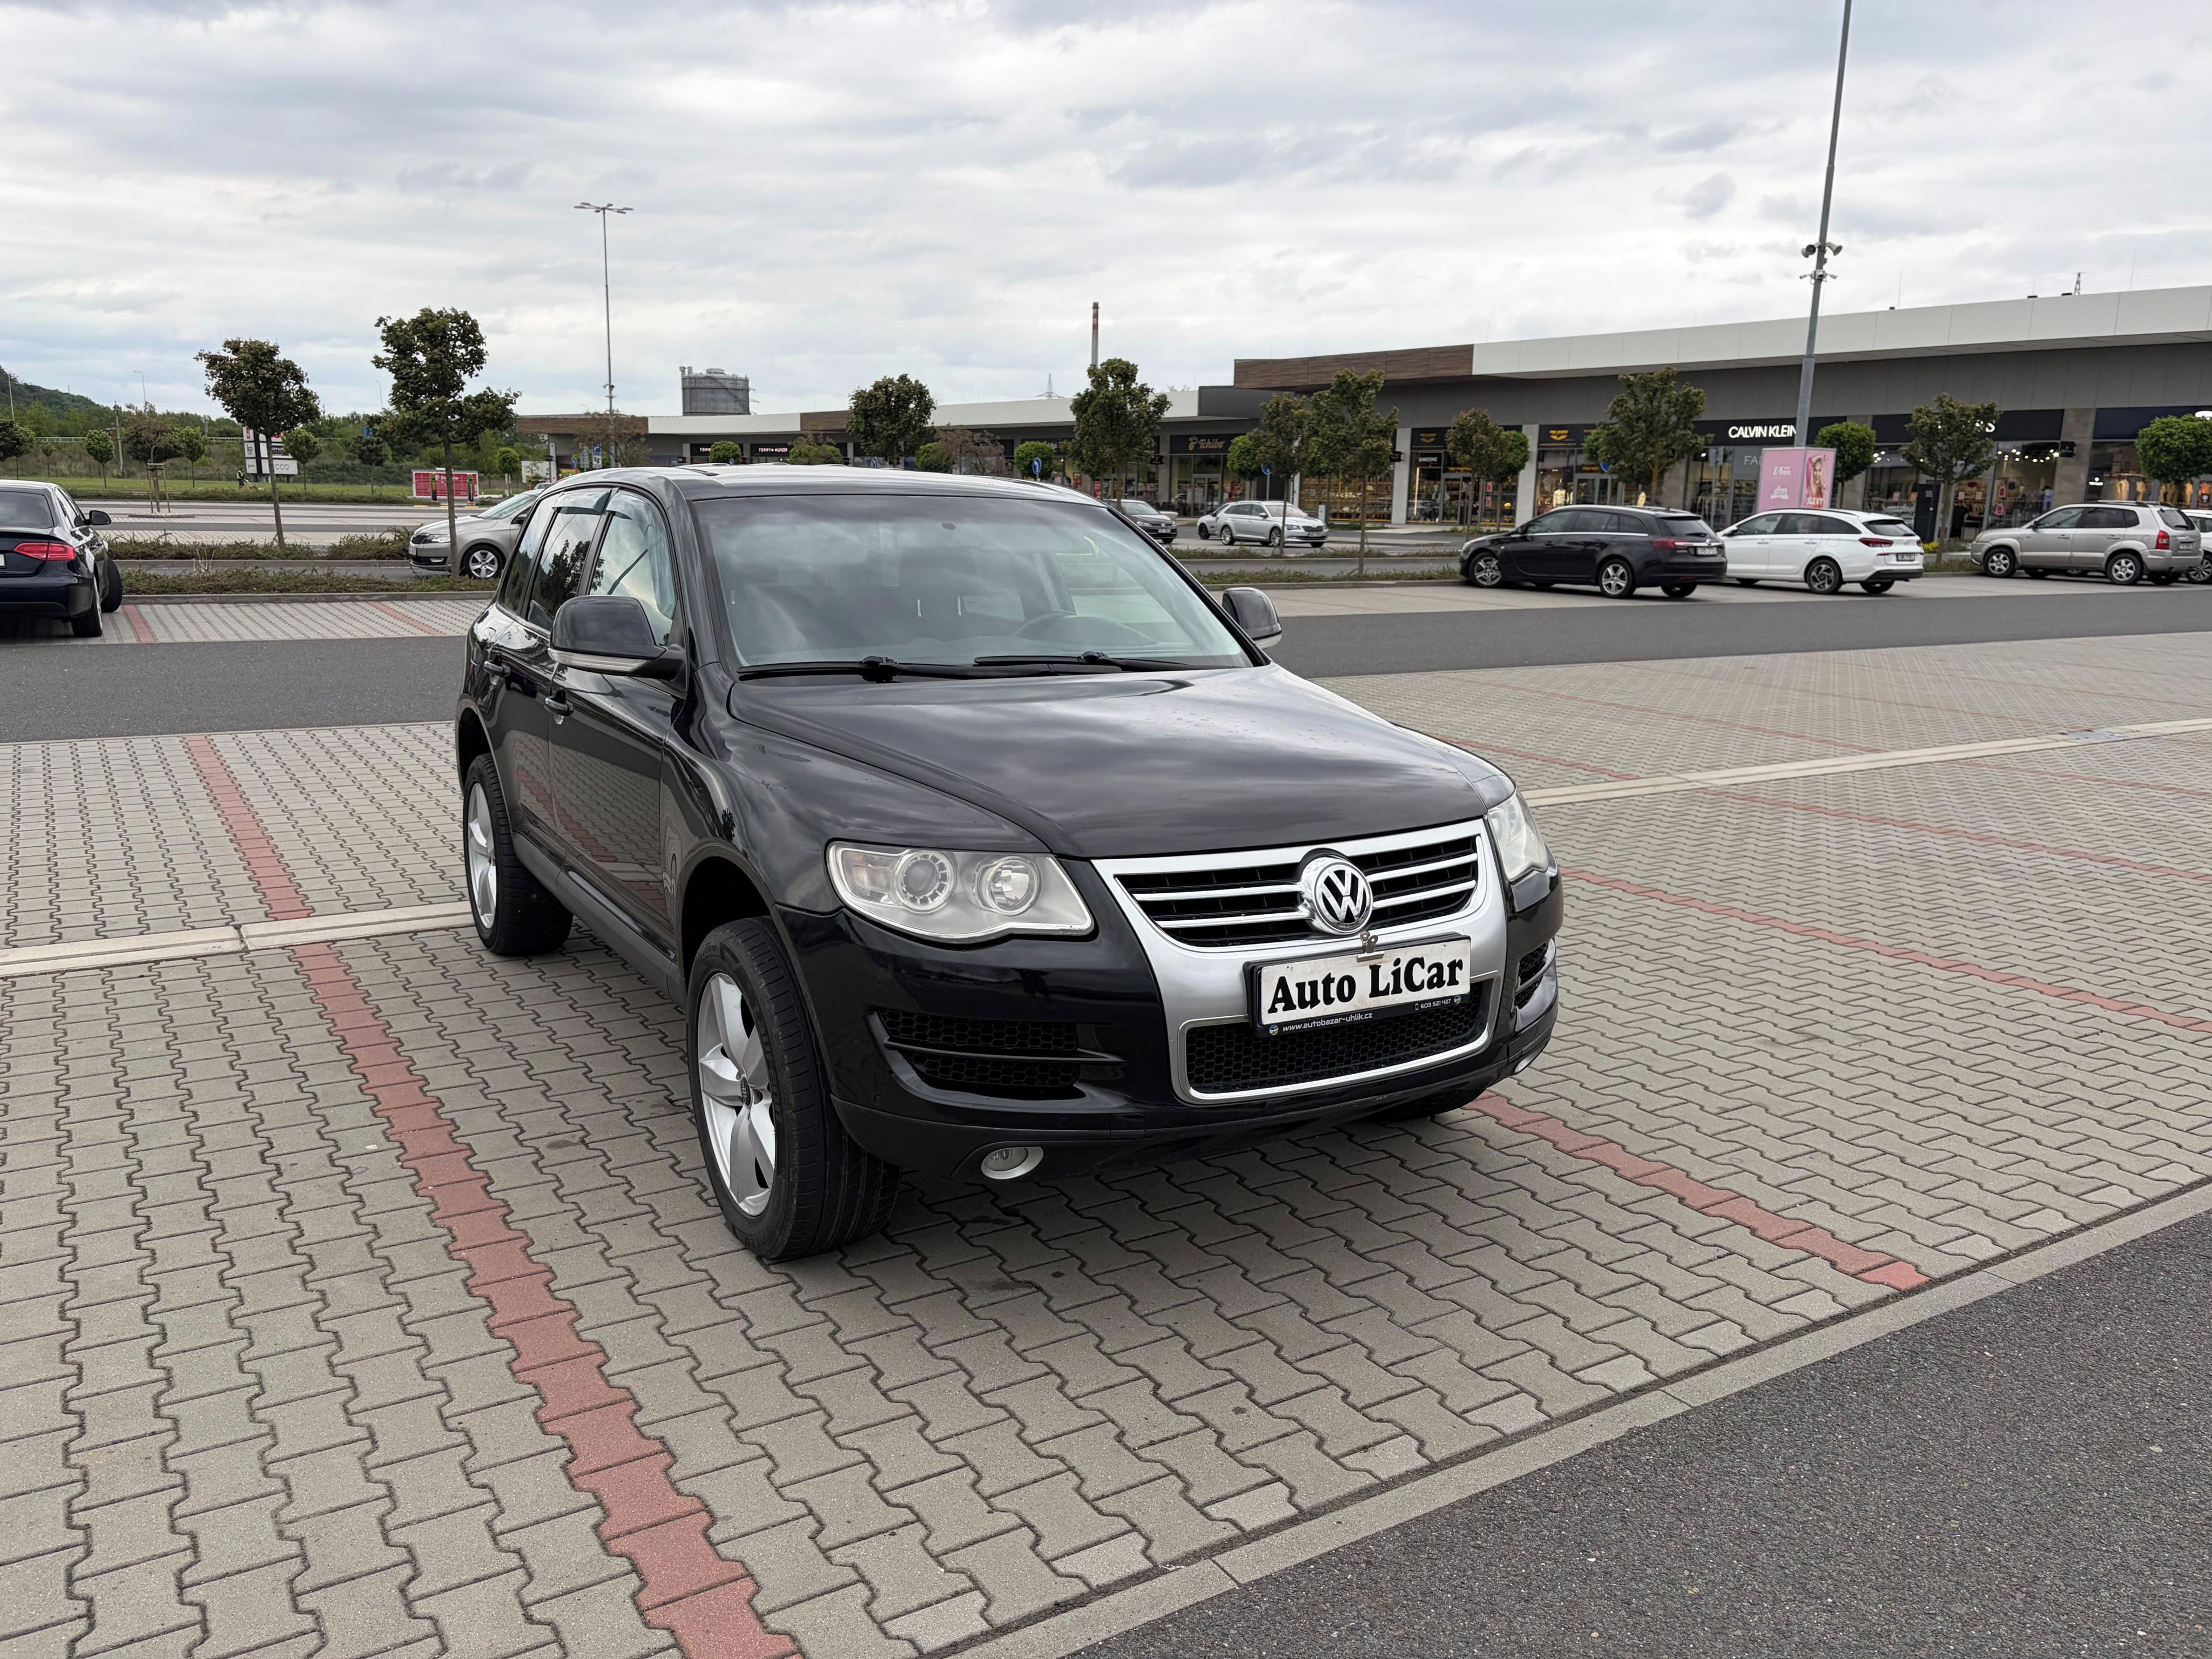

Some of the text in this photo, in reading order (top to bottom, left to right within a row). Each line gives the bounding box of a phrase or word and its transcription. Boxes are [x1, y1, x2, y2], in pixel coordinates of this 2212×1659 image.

[1728, 426, 1768, 439] CALVIN
[1199, 439, 1225, 449] Tchibo
[1267, 956, 1463, 1014] Auto LiCar
[1283, 1013, 1373, 1031] www.autobazar-uhlik.cz
